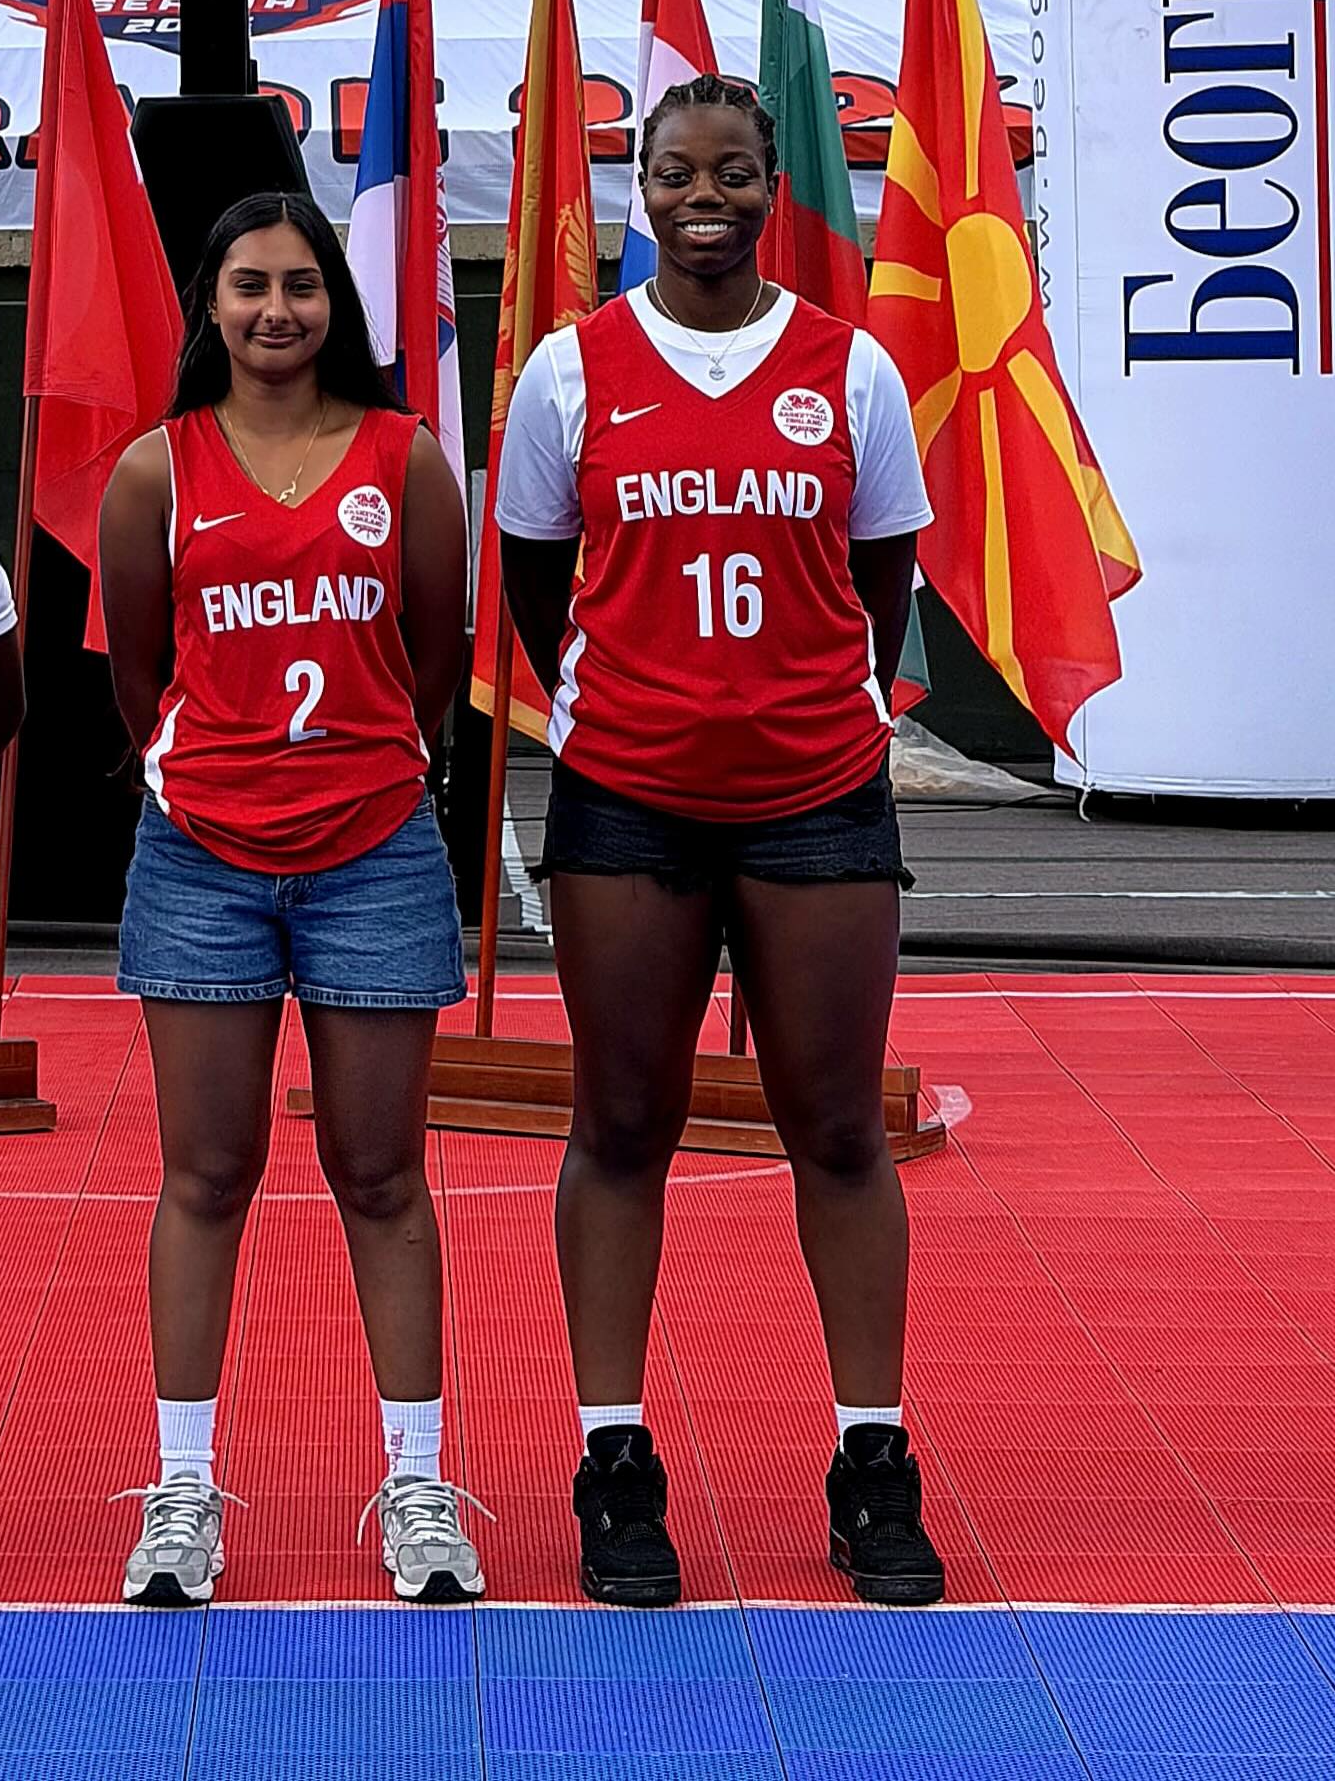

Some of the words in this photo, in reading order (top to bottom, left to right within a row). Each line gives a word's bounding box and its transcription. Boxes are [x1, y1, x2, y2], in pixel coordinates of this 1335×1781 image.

[616, 468, 823, 522] ENGLAND
[200, 574, 385, 634] ENGLAND
[681, 552, 762, 639] 16
[284, 659, 328, 743] 2
